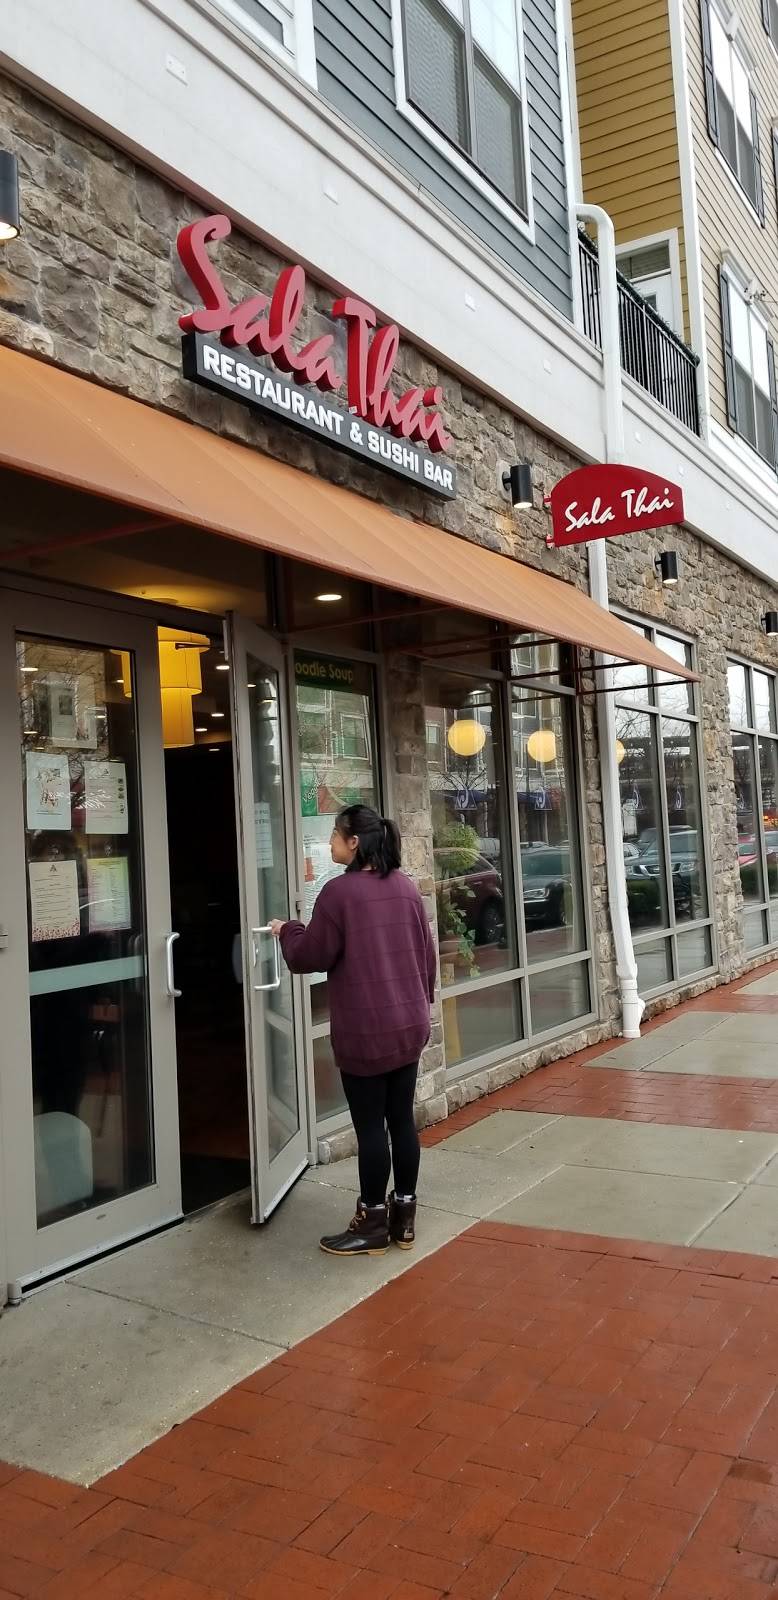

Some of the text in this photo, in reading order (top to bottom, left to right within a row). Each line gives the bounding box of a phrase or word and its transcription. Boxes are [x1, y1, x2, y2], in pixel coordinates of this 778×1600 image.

[177, 214, 453, 453] Sala Thai
[203, 345, 454, 491] RESTAURANT & SUSHI BAR
[564, 486, 674, 532] Sala Thai
[295, 661, 354, 684] oodle Soup
